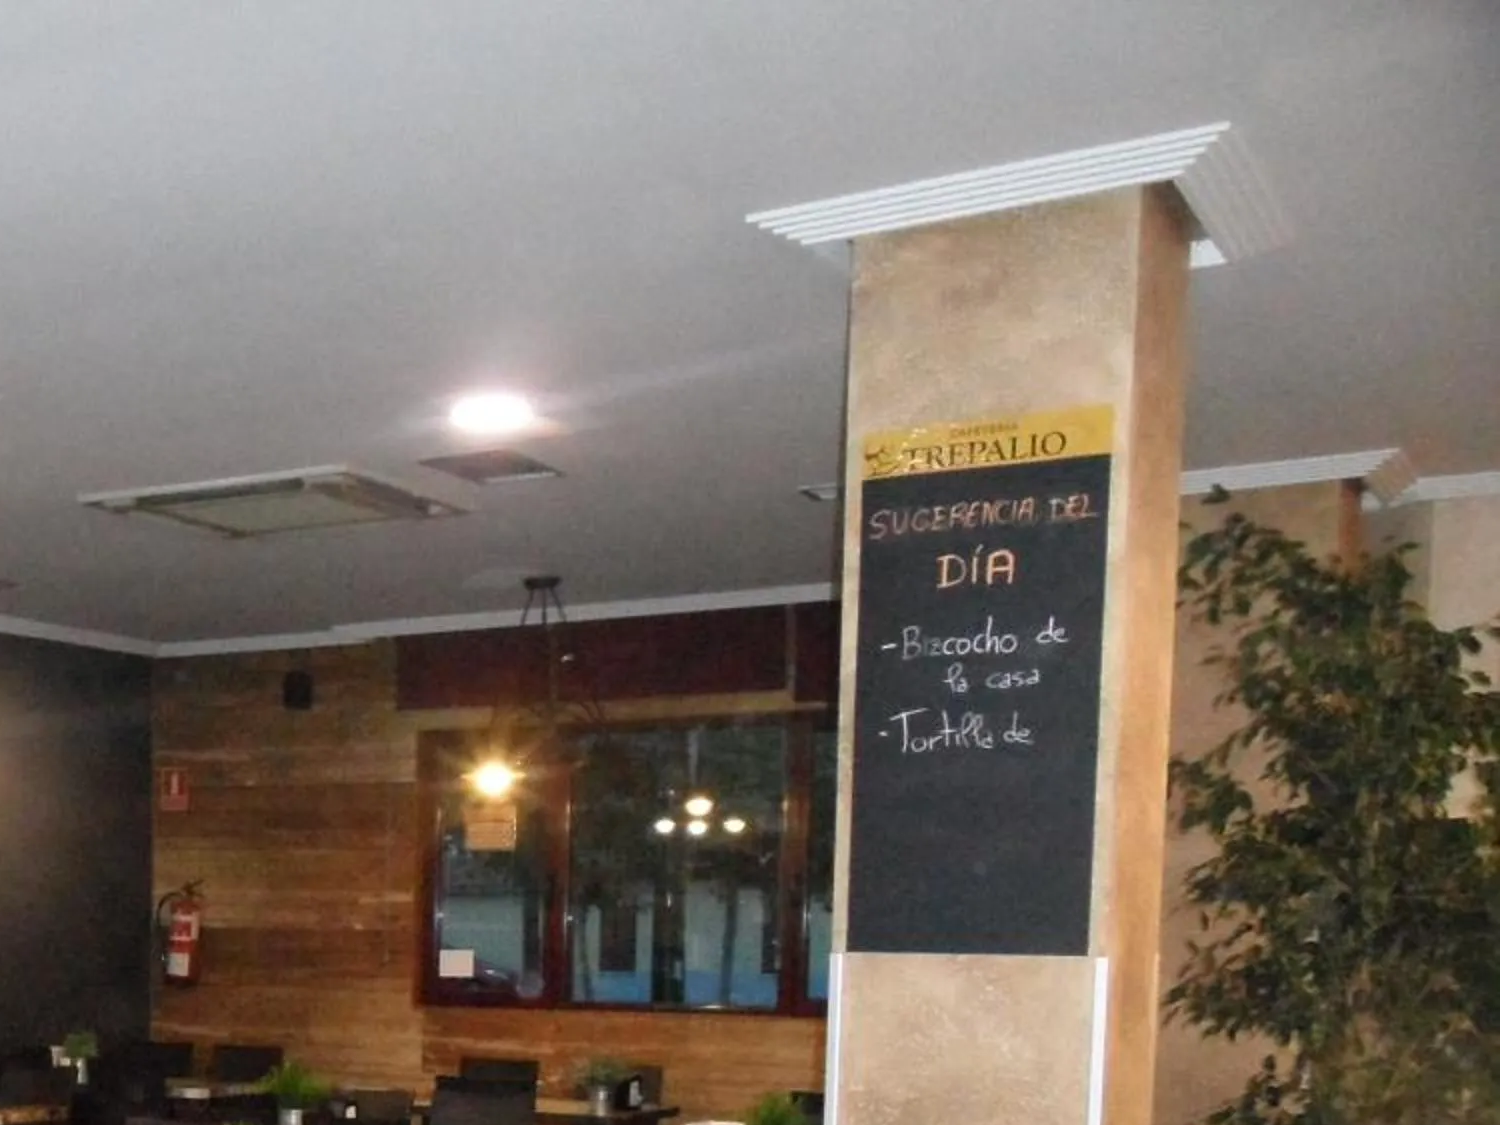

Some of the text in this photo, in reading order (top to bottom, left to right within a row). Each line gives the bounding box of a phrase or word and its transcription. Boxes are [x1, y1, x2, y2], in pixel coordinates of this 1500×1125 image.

[901, 430, 1068, 471] TREPALIO
[1049, 493, 1098, 520] DEL
[935, 544, 1016, 589] DÍA
[1035, 615, 1071, 644] de
[942, 661, 1040, 694] la casa
[1003, 710, 1035, 746] de
